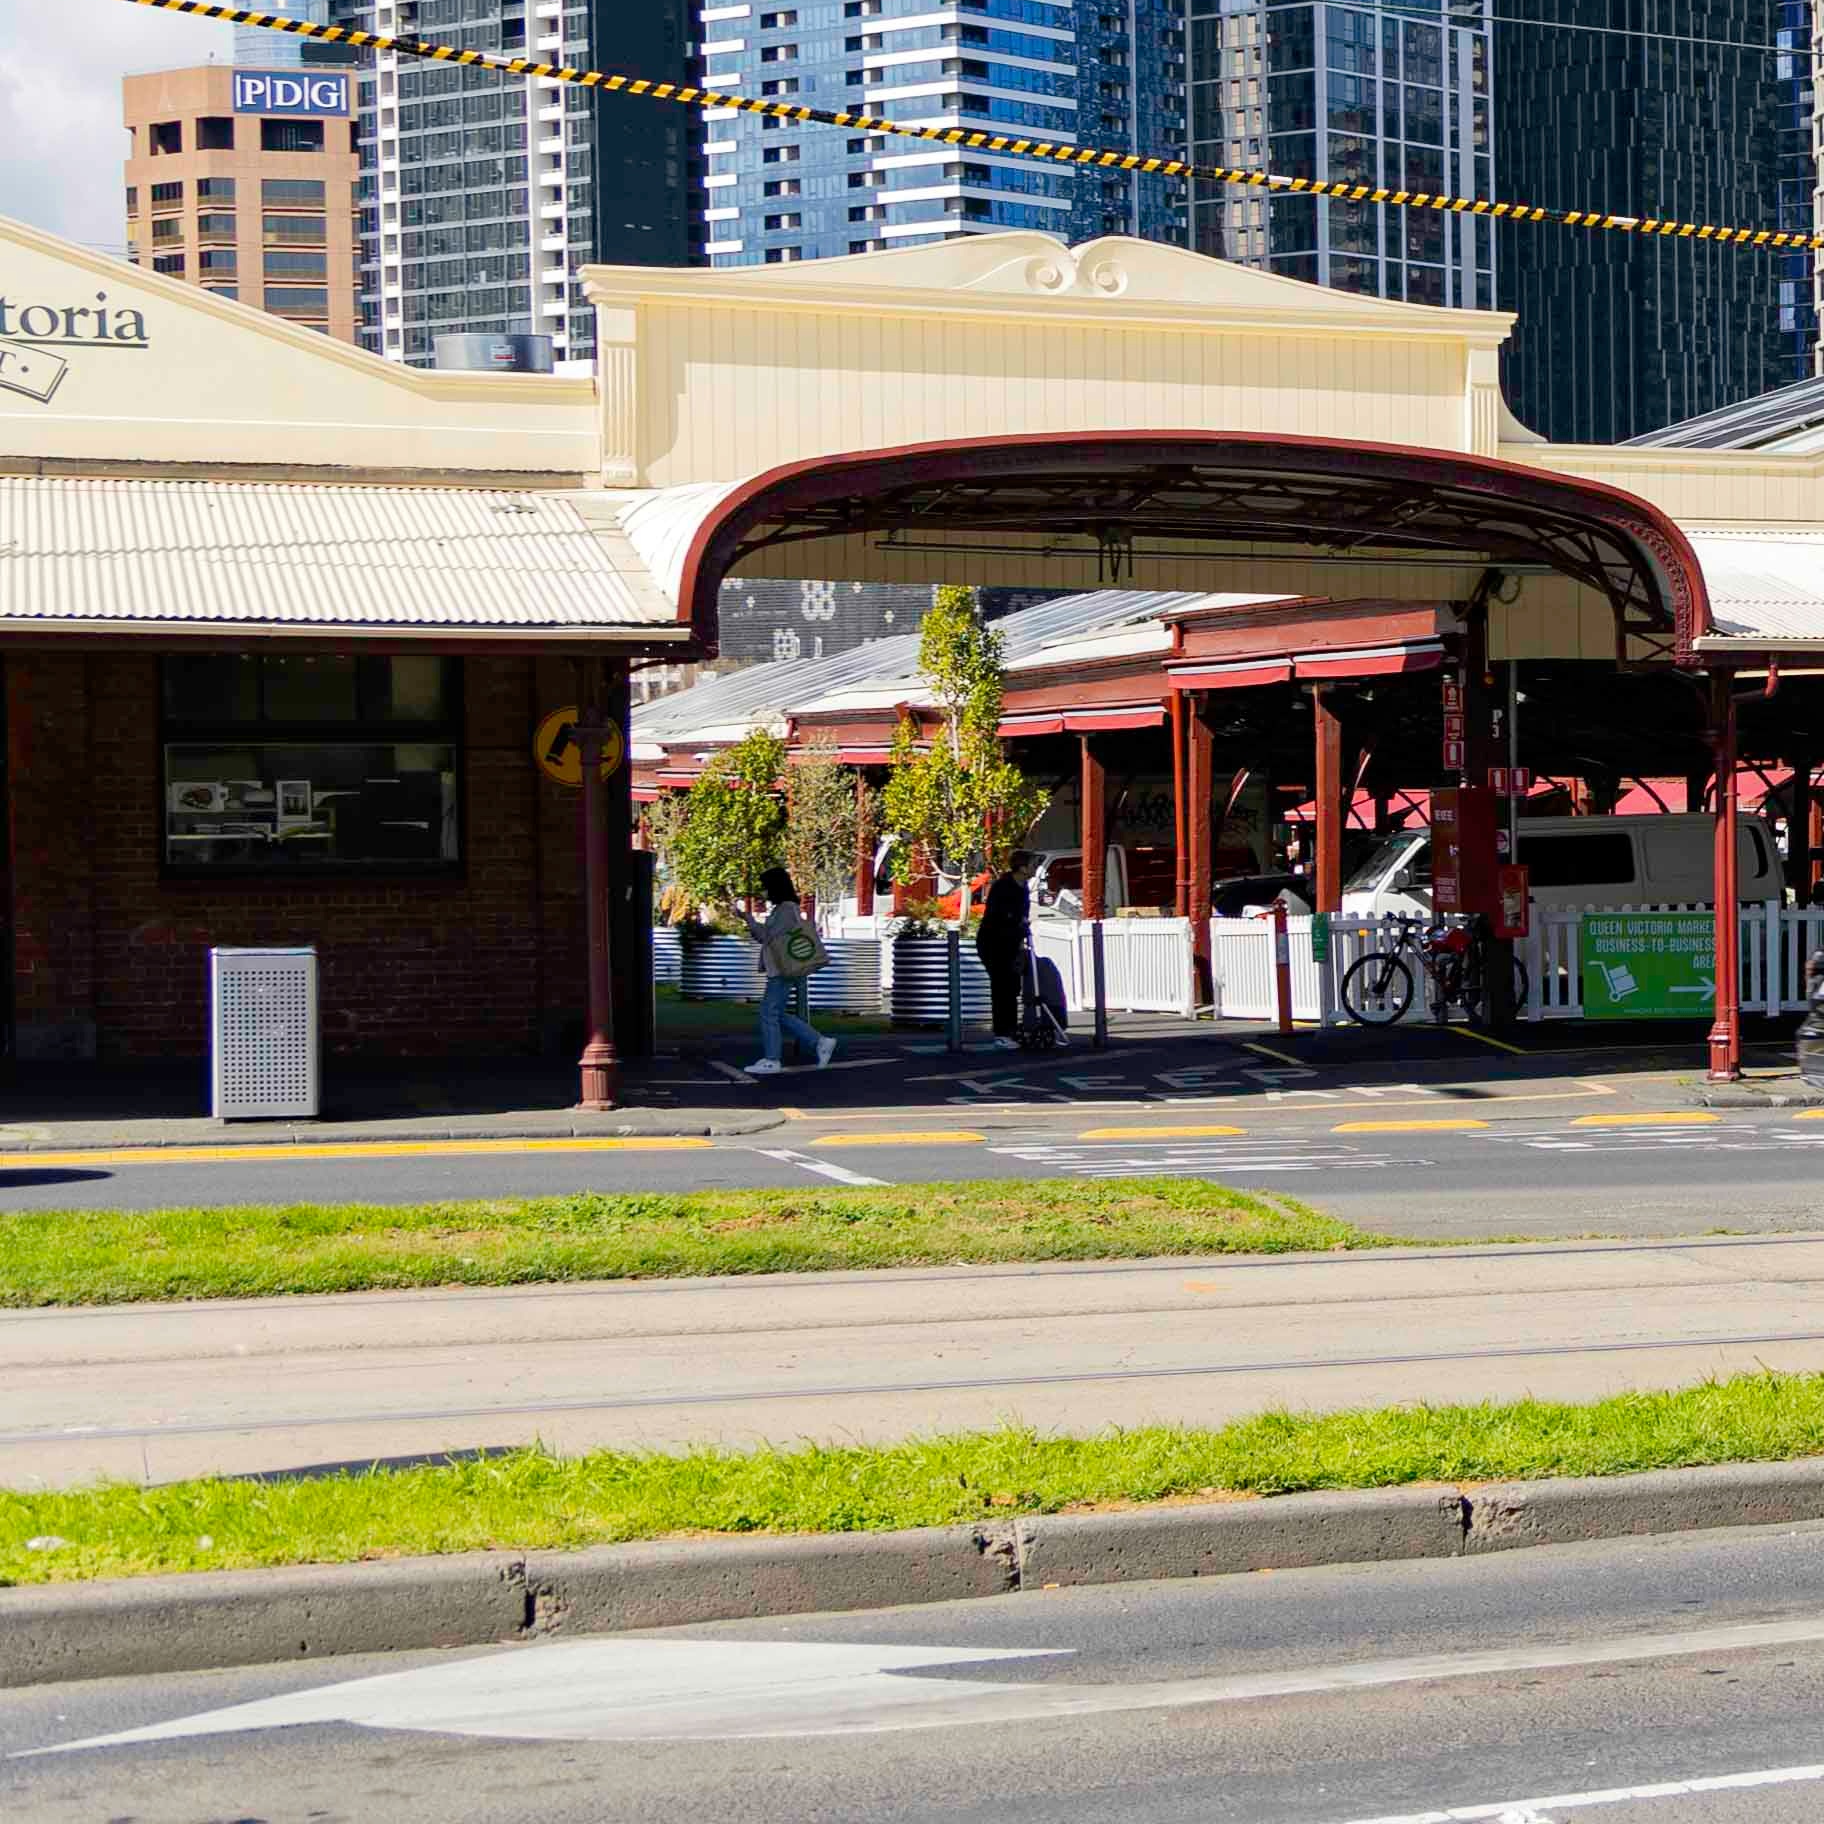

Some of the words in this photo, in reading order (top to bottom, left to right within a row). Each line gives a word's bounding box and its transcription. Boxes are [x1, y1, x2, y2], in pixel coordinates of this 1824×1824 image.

[1590, 919, 1623, 935] QUEEN
[1627, 919, 1673, 935] VICTORIA
[955, 1067, 1320, 1094] KEEP
